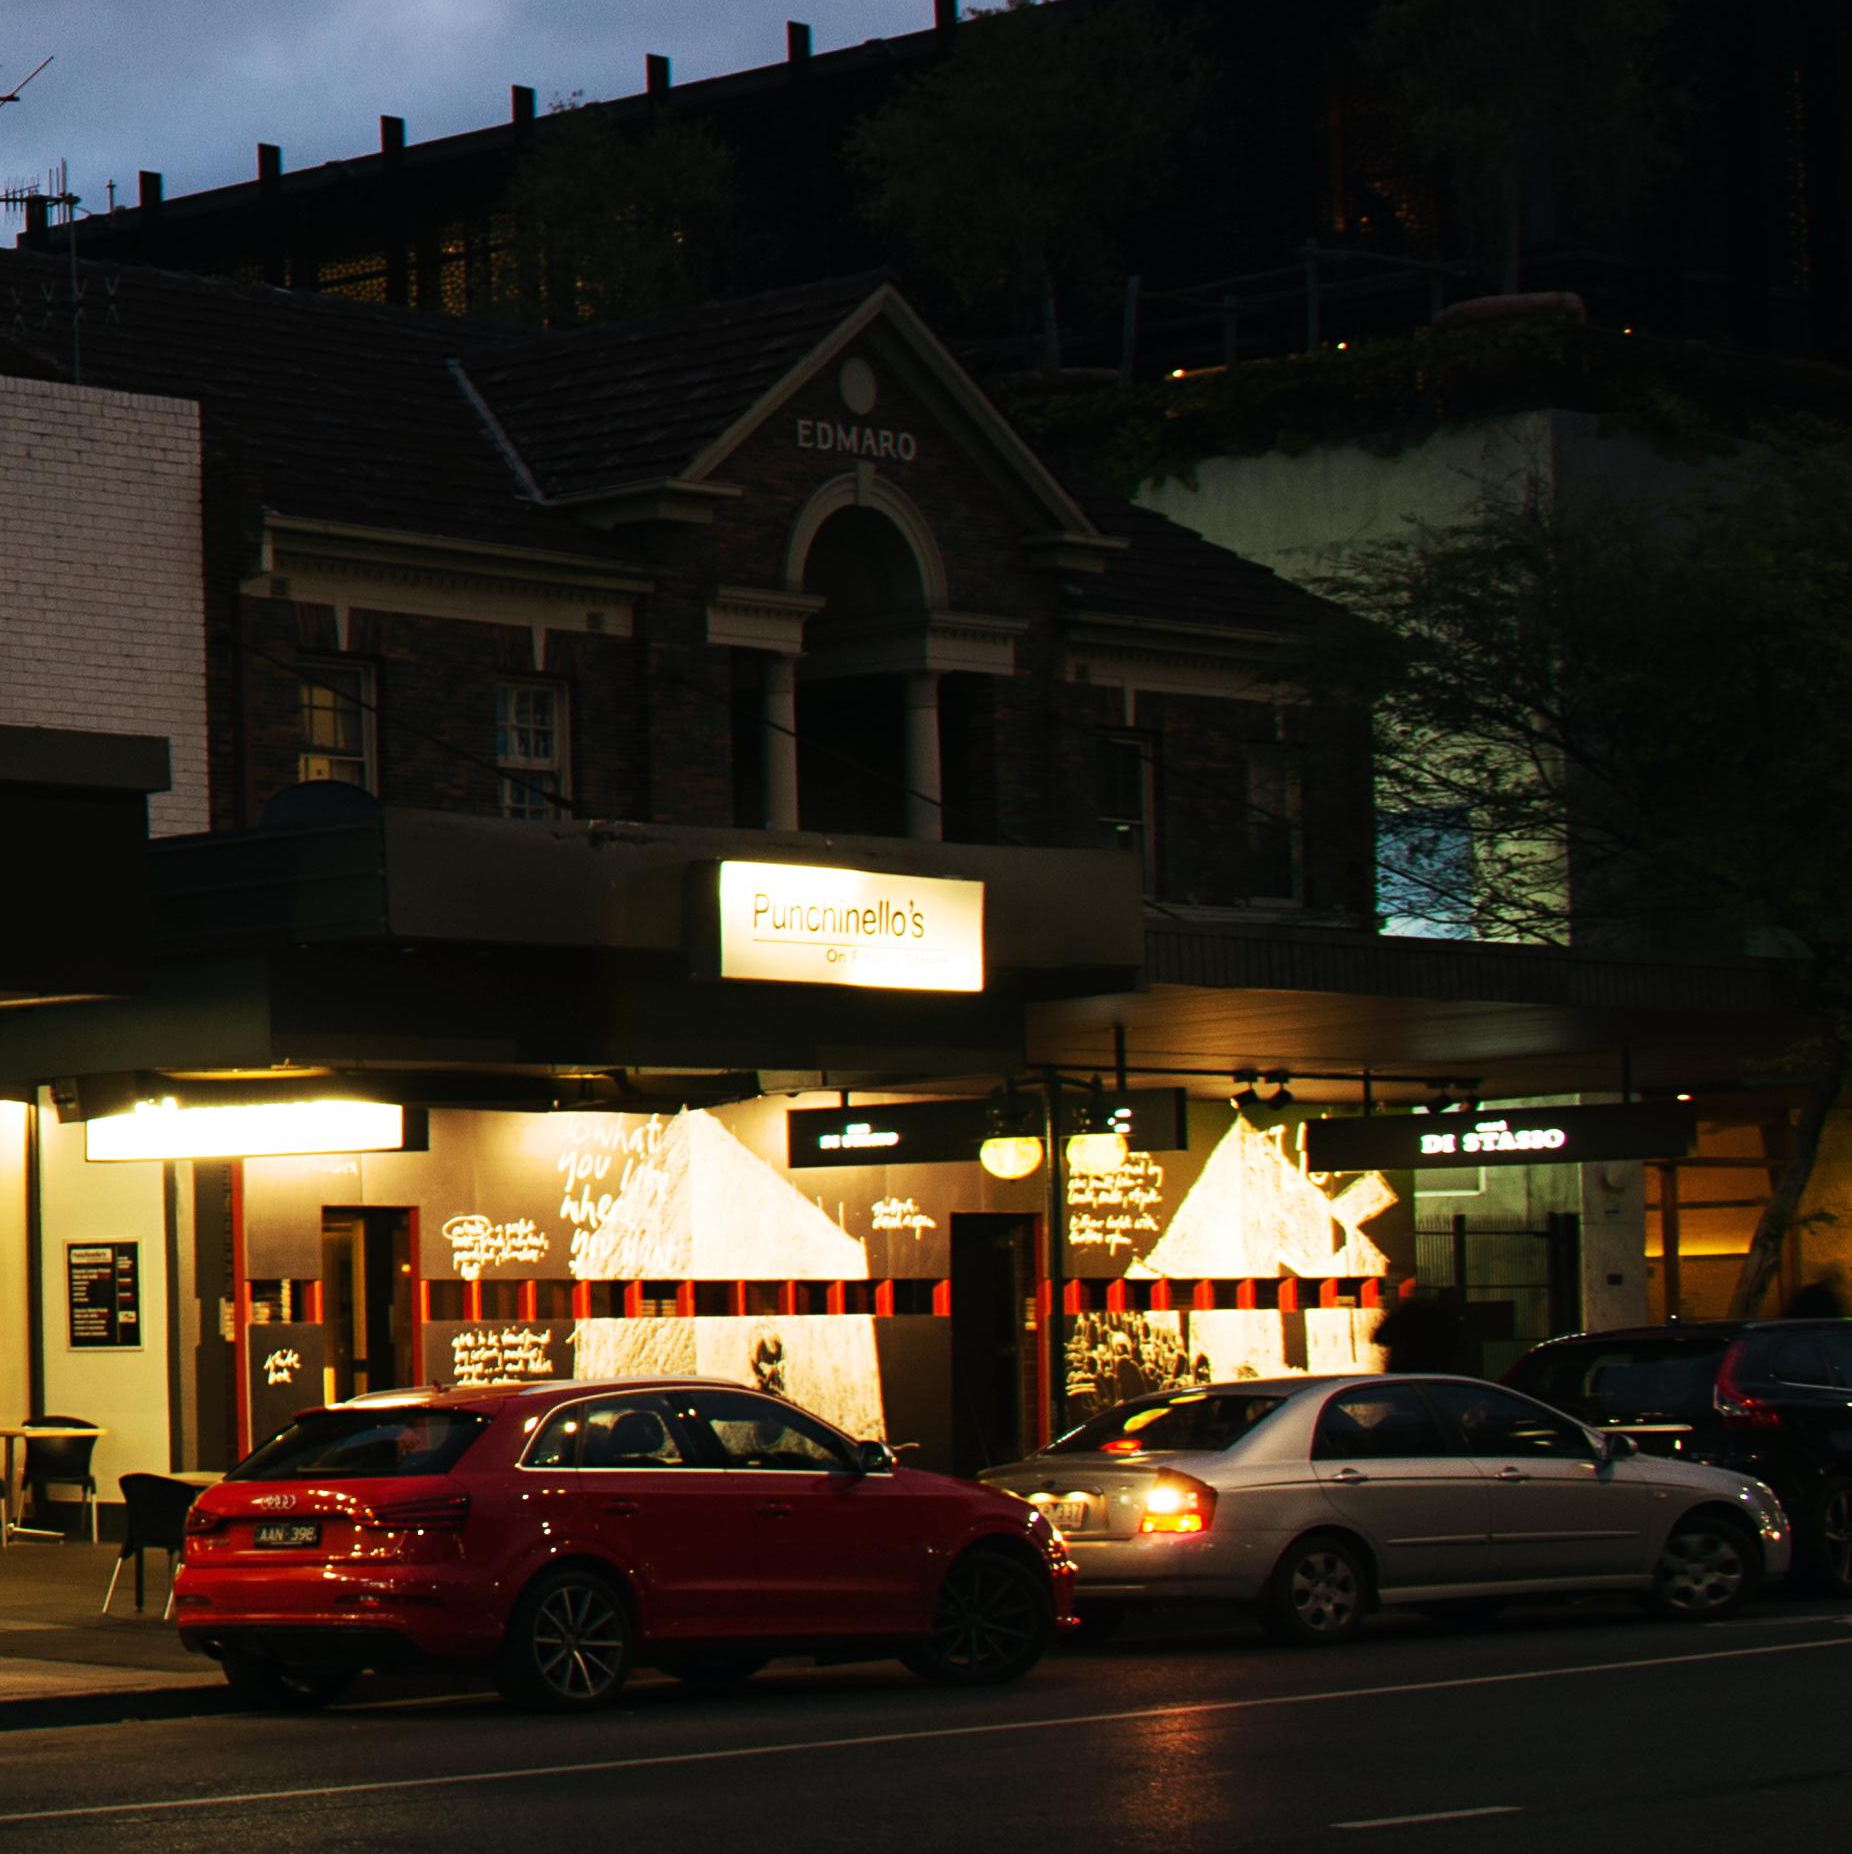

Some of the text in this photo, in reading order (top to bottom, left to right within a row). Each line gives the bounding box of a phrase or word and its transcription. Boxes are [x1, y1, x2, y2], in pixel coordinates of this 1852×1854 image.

[797, 418, 920, 461] EDMARO
[752, 892, 926, 939] Punchinello's
[826, 947, 847, 964] On
[1421, 1134, 1456, 1154] DI
[557, 1149, 612, 1193] you
